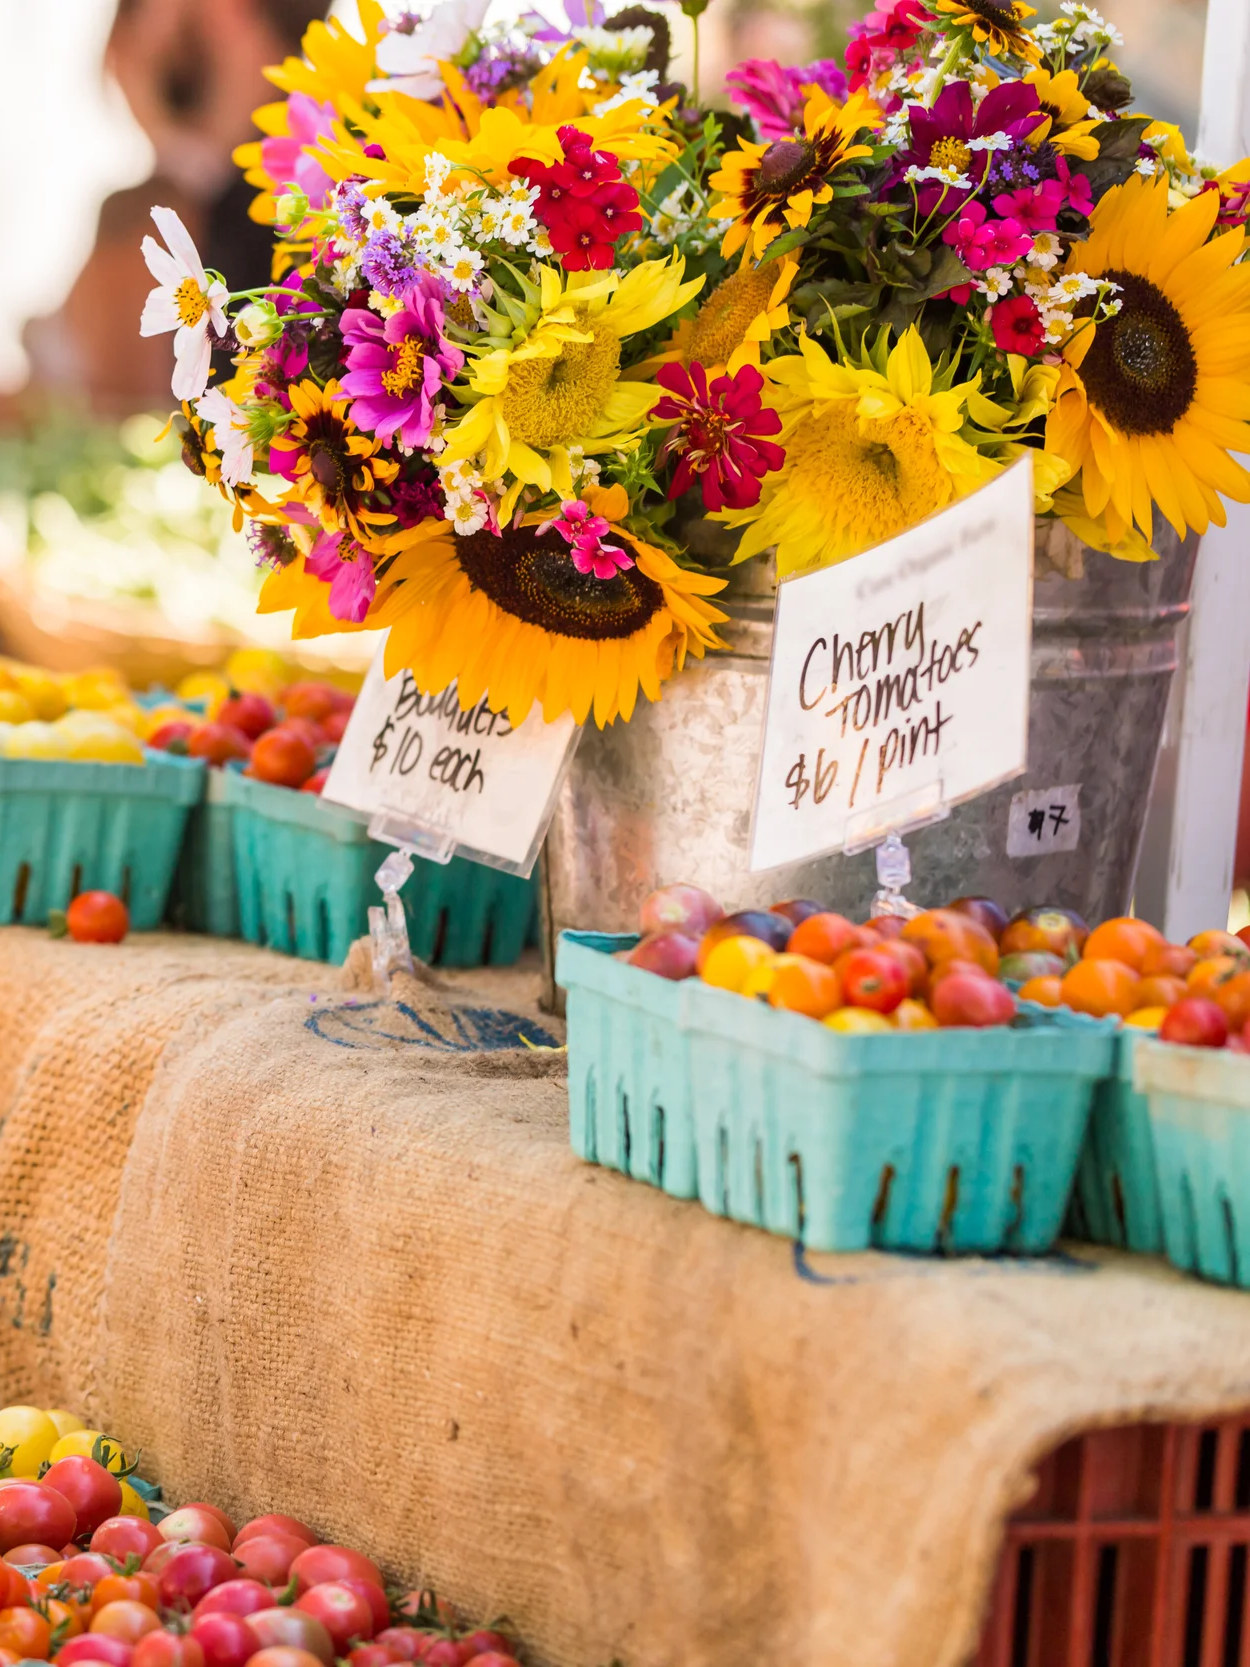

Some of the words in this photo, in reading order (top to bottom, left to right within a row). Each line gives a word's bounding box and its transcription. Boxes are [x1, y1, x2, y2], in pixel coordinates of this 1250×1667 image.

[798, 601, 925, 711] Cherry
[825, 620, 983, 738] Tomatoes
[370, 715, 423, 776] $10
[429, 746, 485, 794] each
